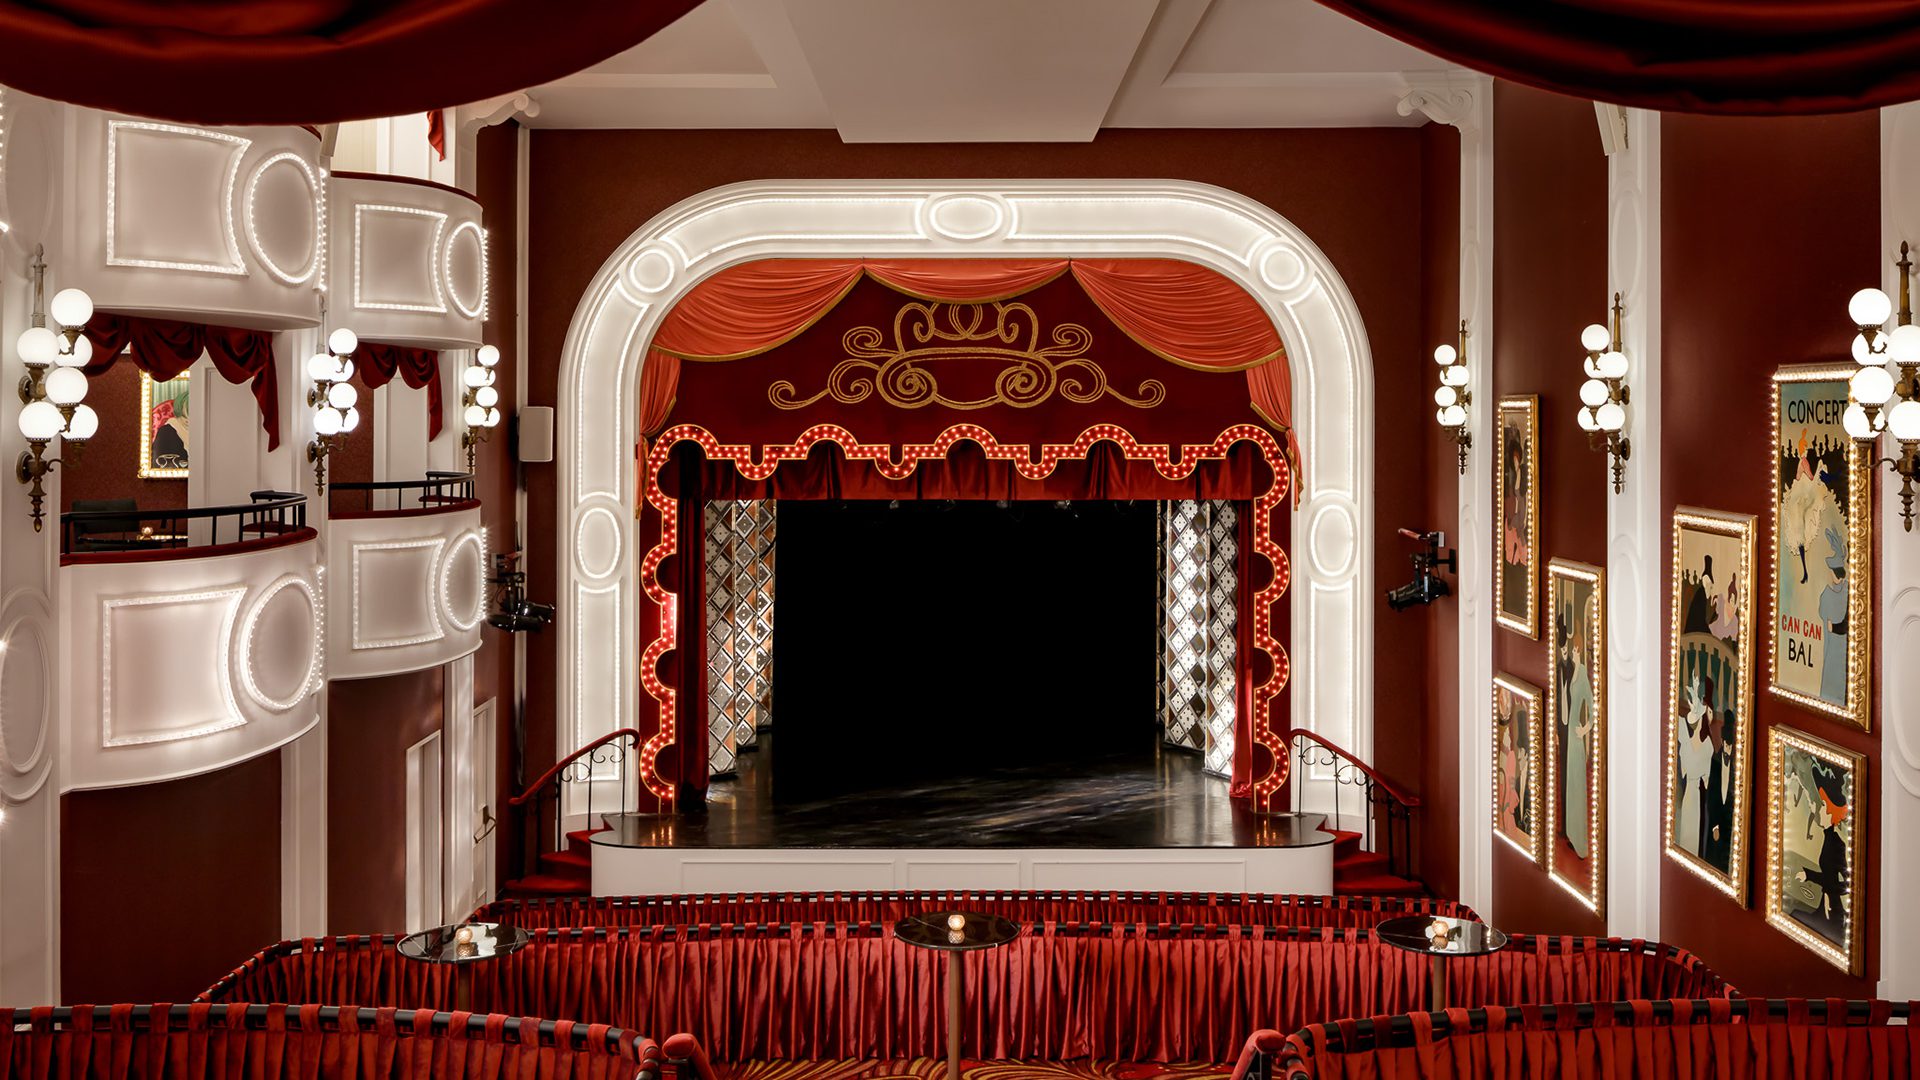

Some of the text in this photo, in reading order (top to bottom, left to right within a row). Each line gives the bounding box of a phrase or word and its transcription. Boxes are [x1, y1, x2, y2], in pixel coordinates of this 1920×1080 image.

[1788, 399, 1847, 425] CONCERT
[1781, 614, 1822, 641] CAN CAN
[1788, 637, 1814, 668] BAL
